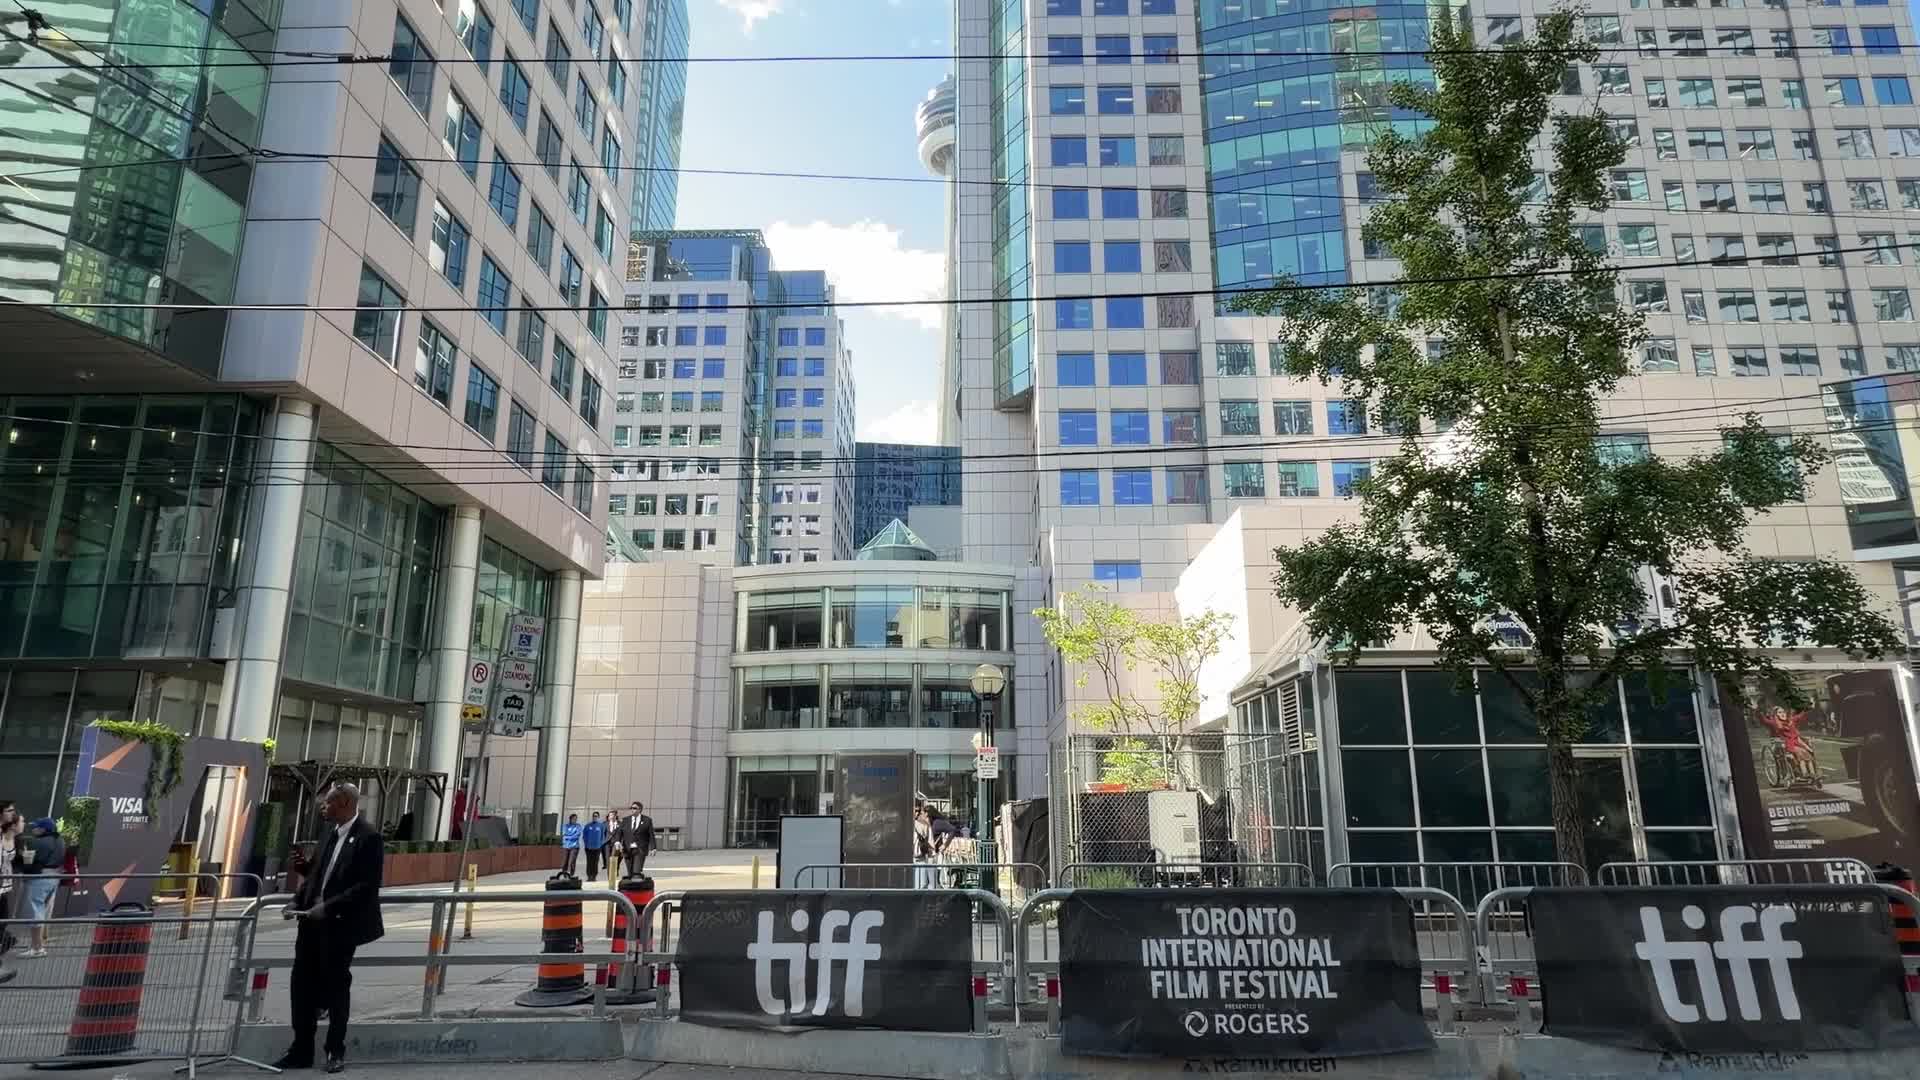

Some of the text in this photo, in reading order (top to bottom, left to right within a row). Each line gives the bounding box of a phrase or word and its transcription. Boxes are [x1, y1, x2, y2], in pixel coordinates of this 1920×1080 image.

[513, 625, 542, 634] STANDING
[524, 617, 534, 625] NO
[504, 671, 532, 681] STANDING
[498, 712, 524, 723] 4 TAXIS
[109, 797, 143, 814] VISA
[1768, 802, 1851, 818] BEING HEUMANN
[1175, 907, 1297, 936] TORONTO
[1141, 938, 1341, 967] INTERNATIONAL
[747, 909, 884, 1017] tiff
[1635, 904, 1803, 1023] tiff
[1150, 970, 1338, 999] FILM FESTIVAL
[1214, 1013, 1309, 1034] ROGERS
